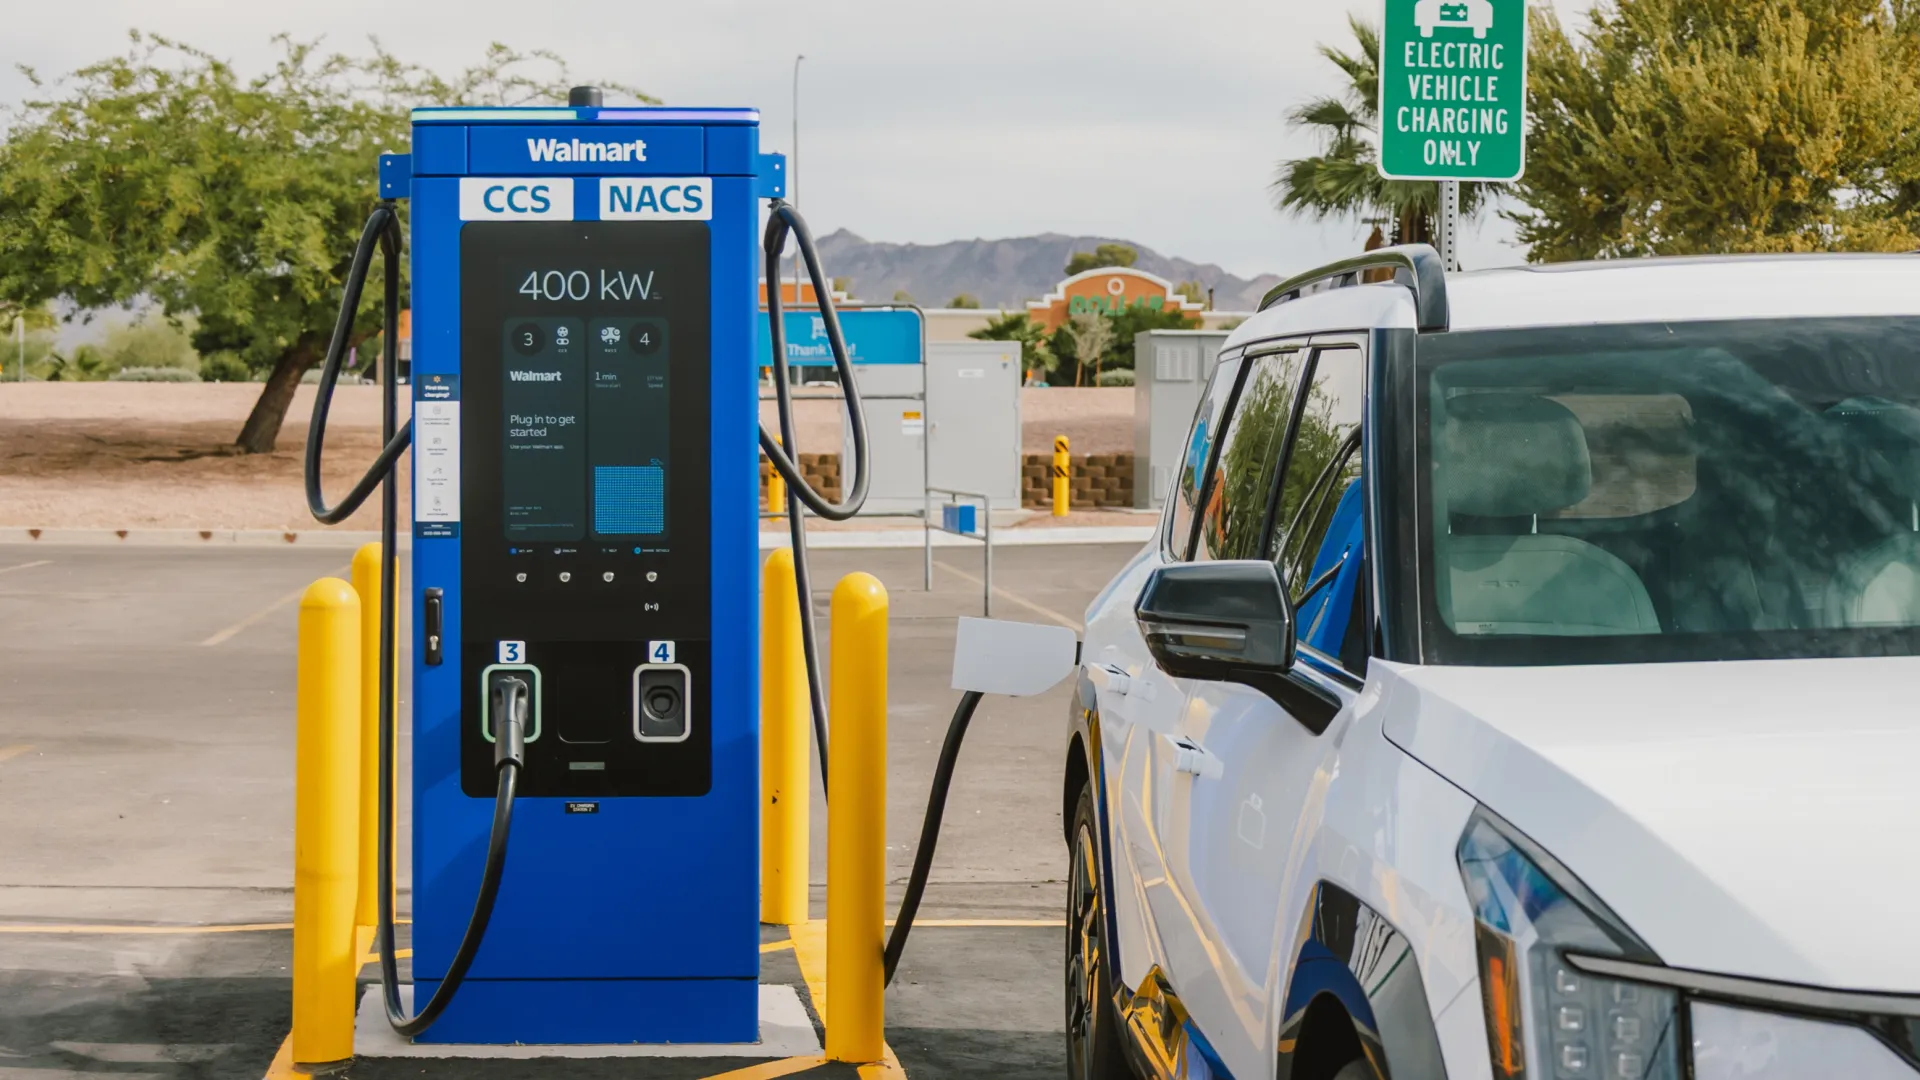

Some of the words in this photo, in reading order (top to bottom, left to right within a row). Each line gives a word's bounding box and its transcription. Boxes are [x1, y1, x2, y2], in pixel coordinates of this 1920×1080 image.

[1404, 41, 1504, 70] ELECTRIC
[1408, 74, 1498, 102] VEHICLE
[1397, 106, 1508, 135] CHARGING
[527, 138, 647, 162] Walmart
[1423, 139, 1481, 166] ONLY
[483, 185, 551, 213] CCS
[608, 184, 704, 213] NACS
[519, 270, 590, 301] 400
[599, 269, 654, 301] kW
[523, 332, 534, 347] 3
[639, 332, 651, 346] 4
[787, 343, 826, 356] Thank
[510, 371, 562, 382] Walmart
[595, 372, 600, 381] 1
[510, 415, 533, 427] Plug
[534, 414, 544, 424] in
[545, 416, 557, 424] to
[558, 416, 576, 427] get
[510, 427, 547, 437] started
[506, 643, 519, 661] 3
[654, 643, 669, 662] 4
